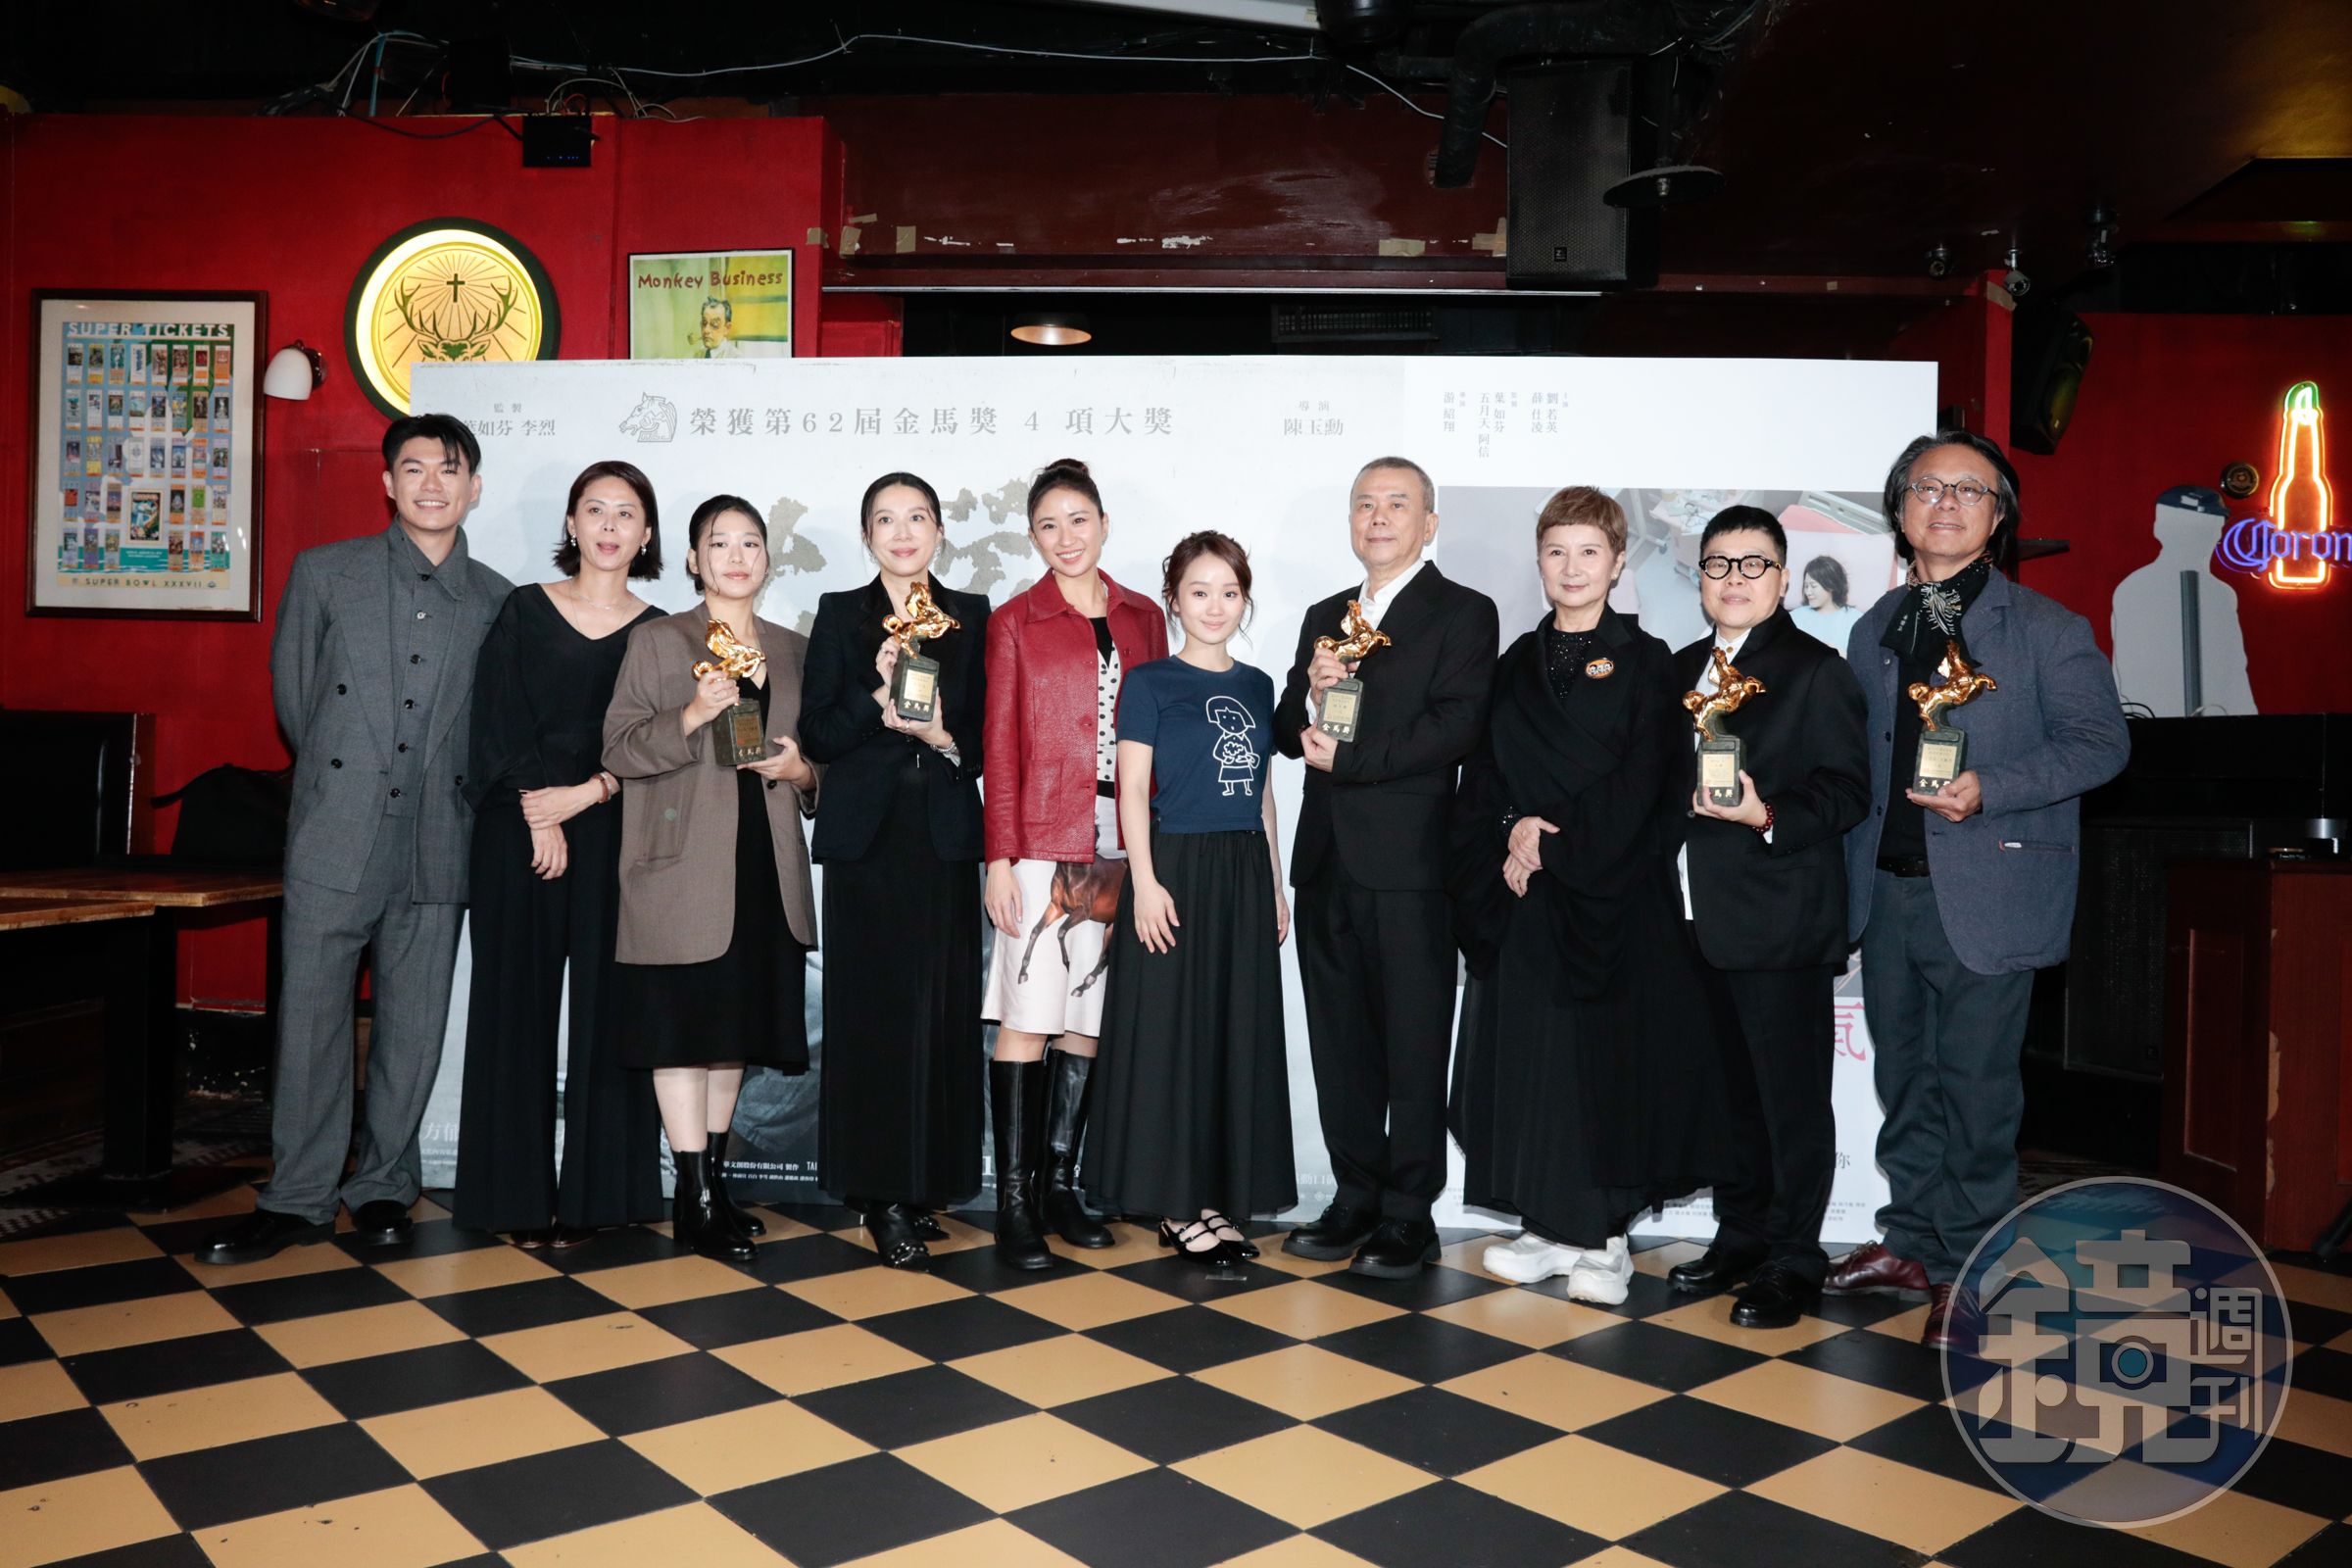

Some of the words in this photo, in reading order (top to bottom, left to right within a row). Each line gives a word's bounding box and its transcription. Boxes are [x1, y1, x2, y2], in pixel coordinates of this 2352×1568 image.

[638, 271, 704, 289] Monkey
[710, 270, 783, 286] Business
[68, 322, 131, 336] SUPER
[143, 323, 228, 337] TICKETS
[521, 418, 556, 436] 李烈
[1024, 410, 1040, 432] 4
[1065, 406, 1173, 435] 項大獎
[85, 577, 120, 587] SUPER
[125, 579, 157, 588] BOWL
[163, 580, 203, 589] XXXVII
